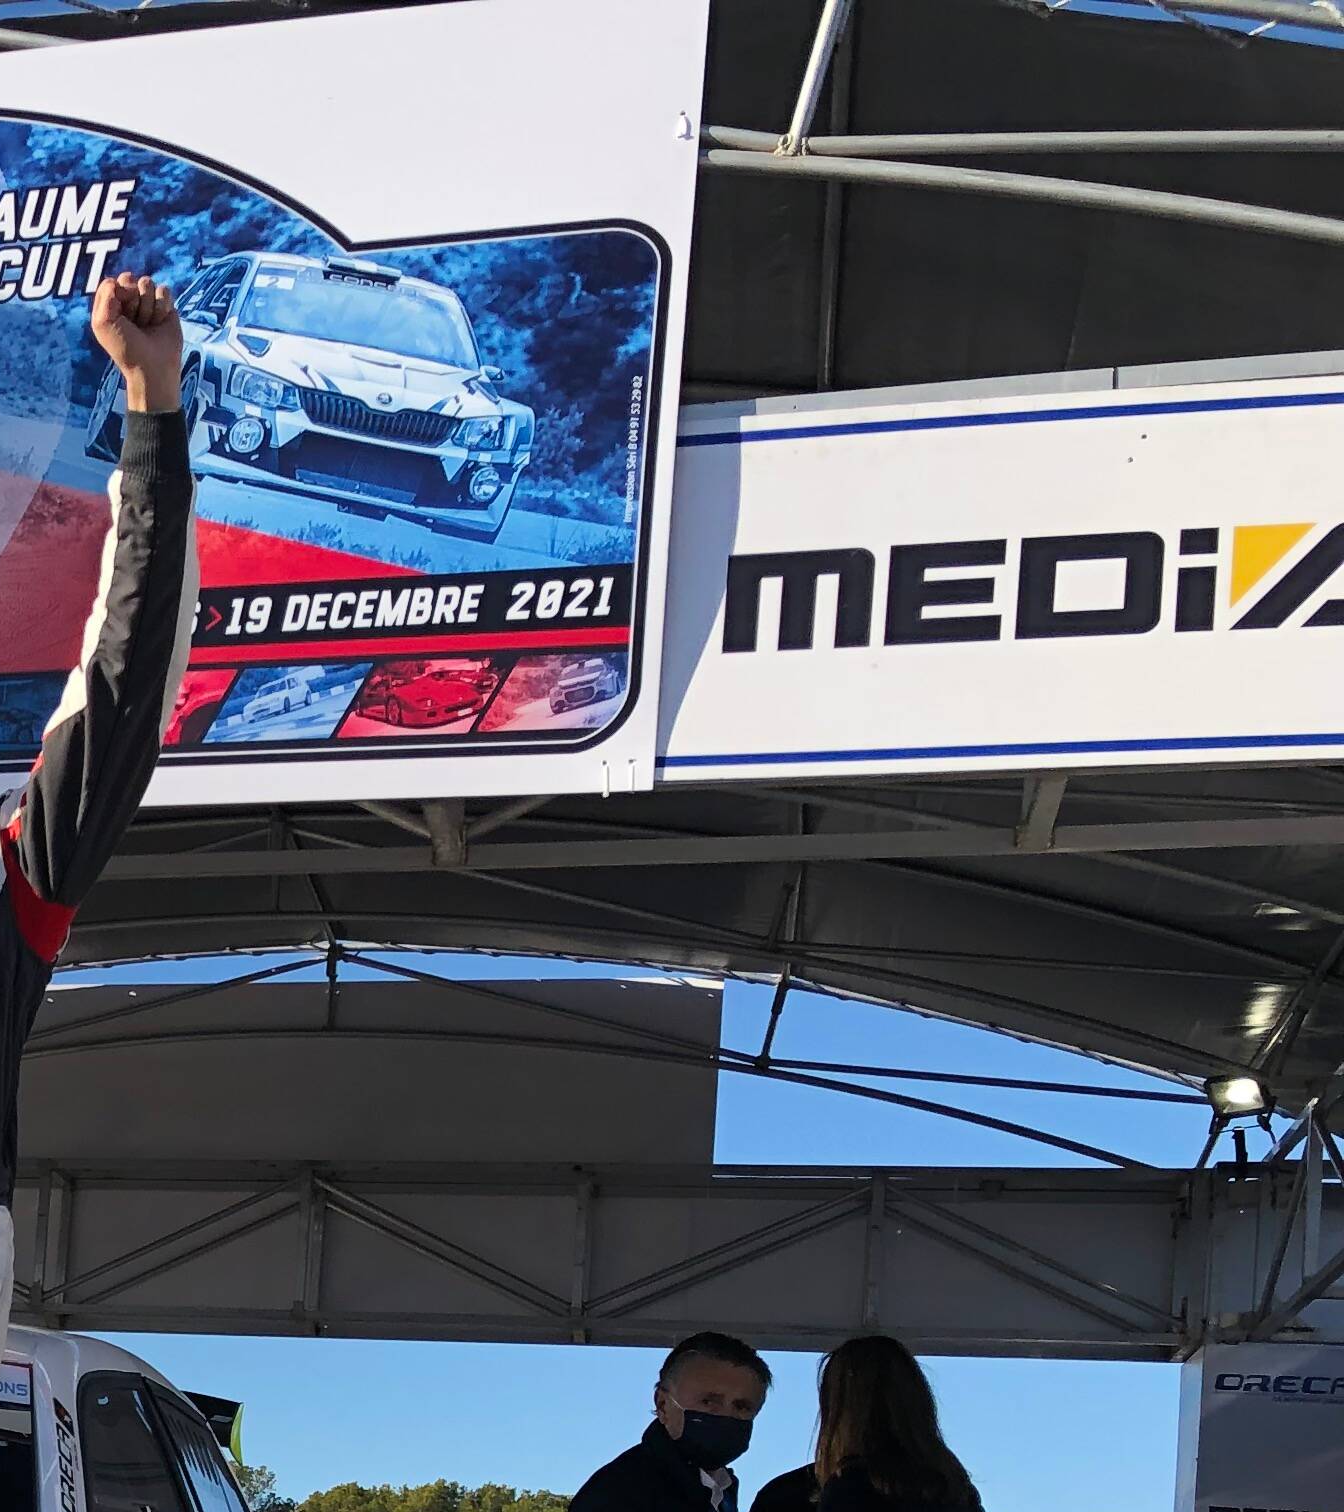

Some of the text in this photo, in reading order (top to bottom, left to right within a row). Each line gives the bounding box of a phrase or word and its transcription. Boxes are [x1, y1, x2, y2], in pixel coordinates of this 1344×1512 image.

[224, 577, 615, 635] 19 DECEMBRE 2021
